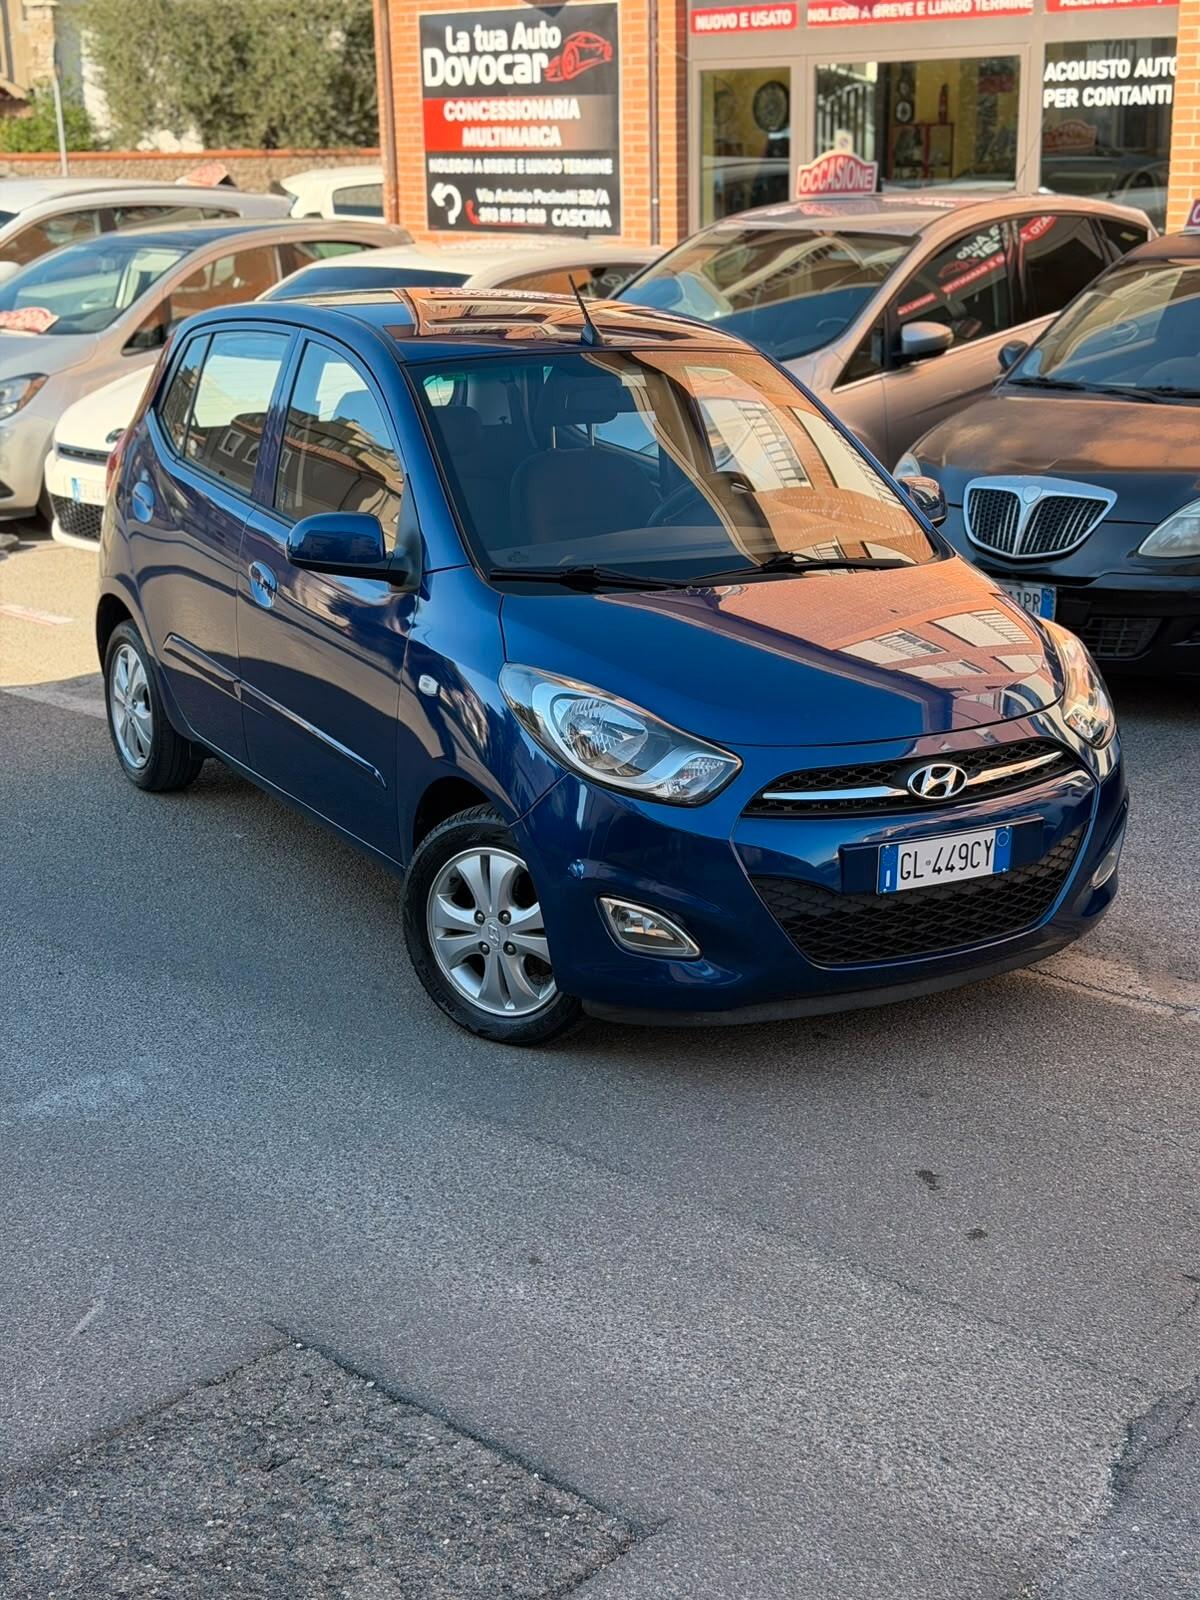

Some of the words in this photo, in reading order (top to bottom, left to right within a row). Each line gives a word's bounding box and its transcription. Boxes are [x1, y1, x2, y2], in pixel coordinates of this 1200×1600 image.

[694, 11, 737, 31] NUOVO
[738, 11, 749, 28] E
[750, 8, 792, 28] USATO
[807, 6, 859, 23] NOLEGGI
[872, 2, 914, 19] BREVE
[916, 1, 926, 16] E
[927, 0, 972, 15] LUNGO
[445, 25, 470, 53] La
[473, 24, 508, 52] tua
[511, 20, 562, 50] Auto
[422, 47, 549, 87] Dovocar
[1043, 58, 1131, 82] ACQUISTO
[1043, 87, 1079, 109] PER
[1082, 84, 1173, 107] CONTANTI
[443, 98, 581, 122] CONCESSIONARIA
[462, 126, 562, 147] MULTIMARCA
[800, 156, 873, 193] OCCASIONE
[551, 208, 612, 228] CASCINA
